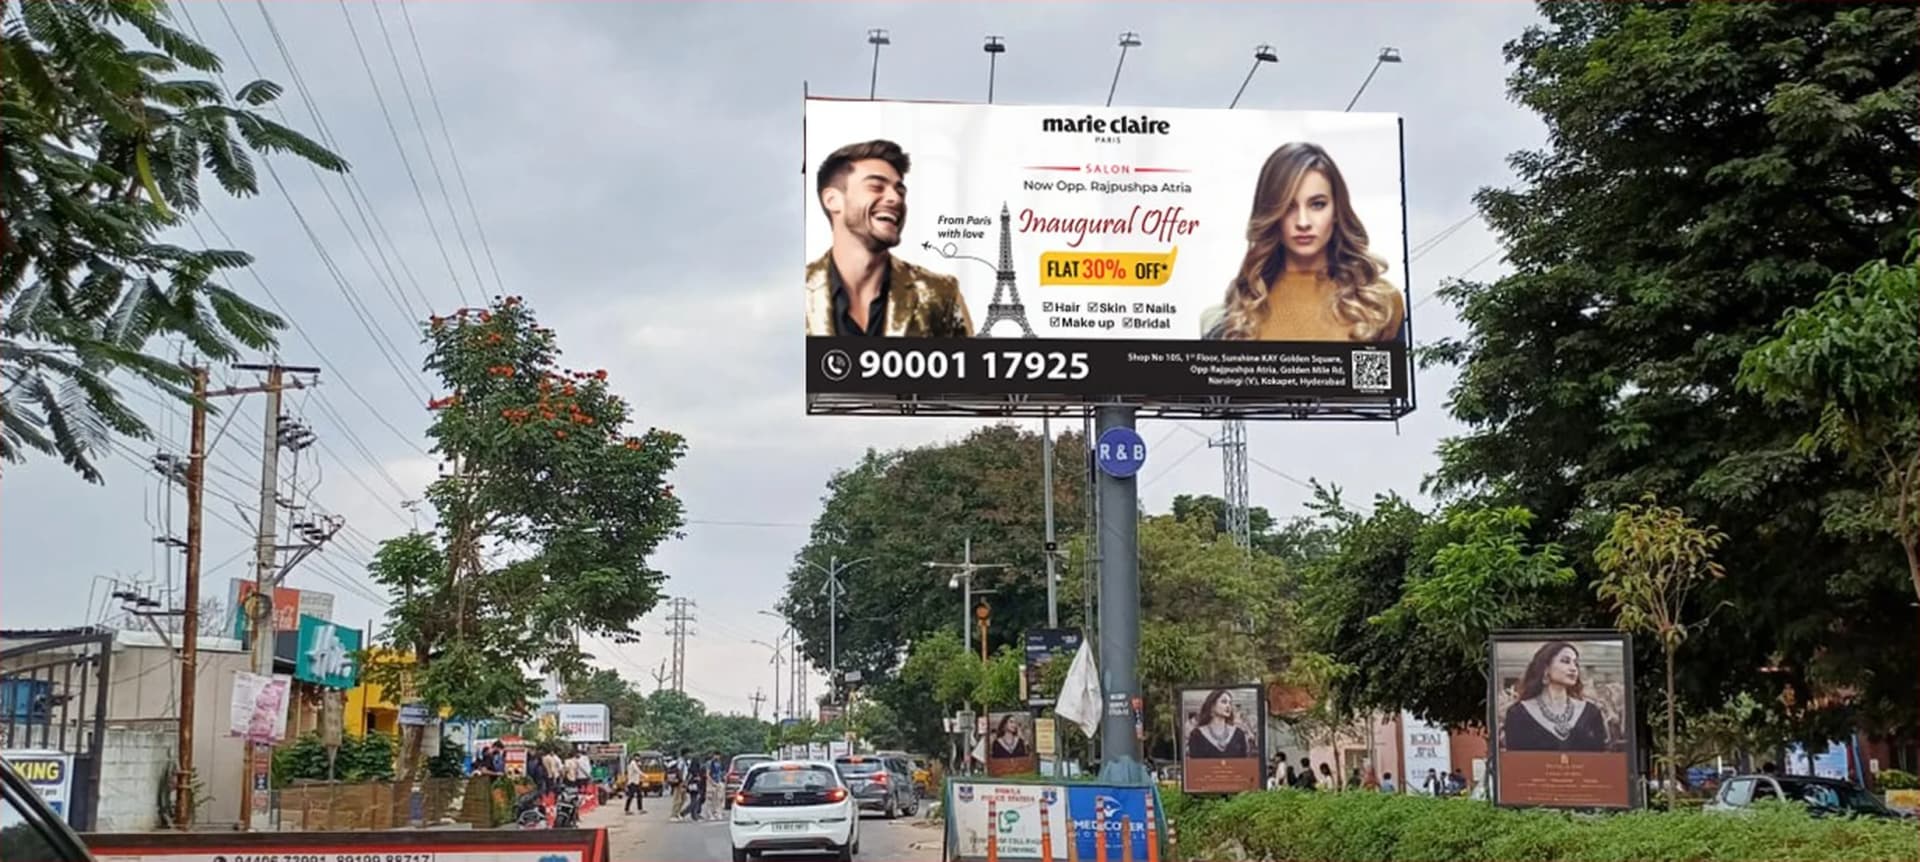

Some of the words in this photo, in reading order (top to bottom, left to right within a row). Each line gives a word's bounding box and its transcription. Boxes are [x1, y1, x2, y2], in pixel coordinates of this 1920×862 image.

[1042, 114, 1106, 133] marie
[1110, 115, 1171, 135] claire
[1085, 164, 1130, 174] SALON
[1023, 180, 1054, 191] Now
[1056, 181, 1087, 194] Opp.
[1091, 181, 1158, 194] Rajpushpa
[1160, 182, 1192, 193] Atria
[937, 215, 965, 225] From
[966, 216, 992, 225] Paris
[1019, 205, 1141, 247] Inaugural
[1141, 206, 1200, 242] Offer
[938, 228, 961, 239] with
[963, 228, 985, 239] love
[1047, 260, 1080, 277] FLAT
[1082, 258, 1126, 279] 30%
[1055, 302, 1080, 312] Hair
[1100, 303, 1126, 313] Skin
[1145, 303, 1177, 314] Nails
[1062, 317, 1096, 328] Make
[1098, 319, 1115, 330] up
[1134, 318, 1171, 329] Bridal
[1128, 352, 1150, 362] Shop
[1151, 352, 1164, 361] No
[1221, 353, 1260, 362] Sunshine
[1261, 354, 1278, 362] KAY
[1279, 354, 1310, 363] Golden
[859, 350, 966, 379] 90001
[982, 352, 1090, 380] 17925
[1280, 366, 1311, 375] Golden
[1312, 366, 1330, 375] Mile
[1300, 377, 1346, 388] Hyderabad
[1100, 443, 1111, 460] R
[1116, 443, 1128, 460] &
[1133, 444, 1144, 460] B
[13, 761, 60, 780] KING
[1073, 820, 1145, 832] MEDCOER
